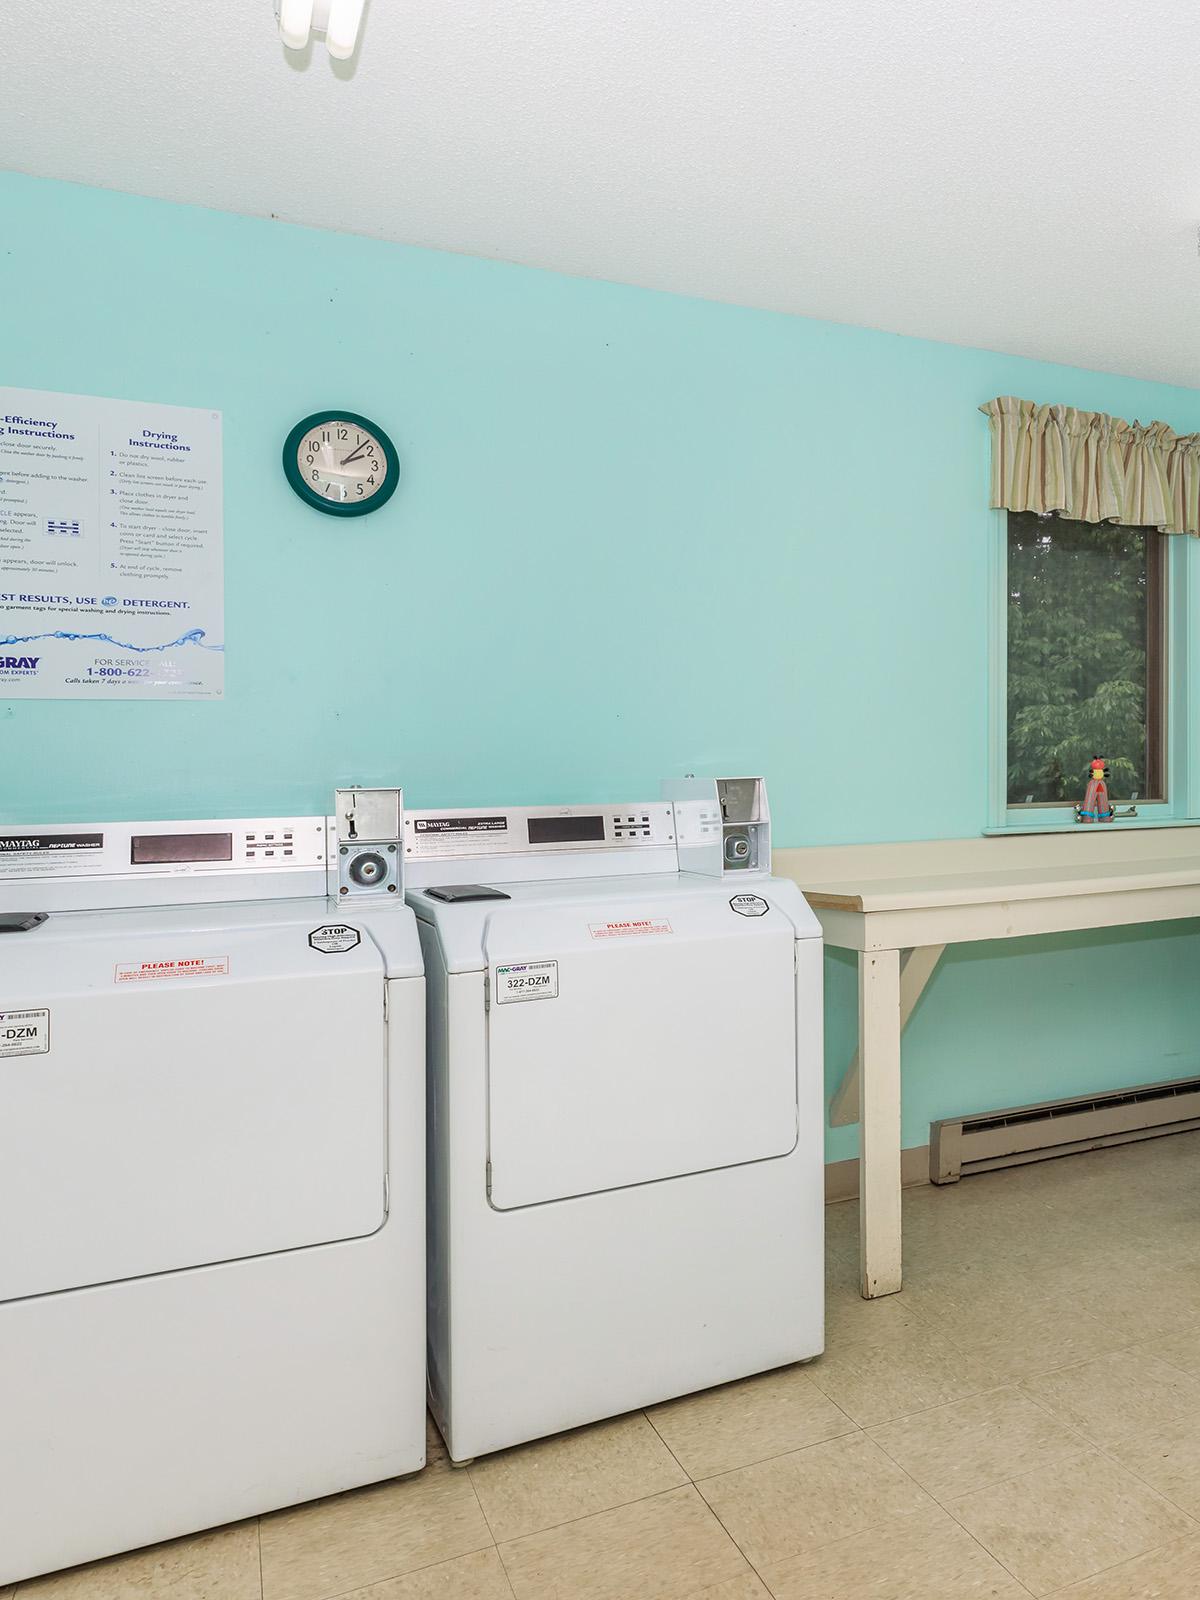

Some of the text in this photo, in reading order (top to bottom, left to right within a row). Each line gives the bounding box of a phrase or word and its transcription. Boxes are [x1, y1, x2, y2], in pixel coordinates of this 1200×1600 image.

[8, 426, 75, 440] Instructions
[142, 430, 178, 442] Drying
[322, 431, 330, 442] 11
[337, 429, 348, 440] 12
[129, 439, 191, 451] Instructions
[356, 434, 360, 445] 1
[309, 441, 320, 452] 10
[366, 445, 374, 457] 2
[306, 454, 314, 466] 9
[371, 460, 379, 472] 3
[311, 470, 319, 481] 8
[367, 475, 375, 485] 4
[356, 484, 364, 495] 5
[19, 594, 72, 605] RESULTS,
[76, 597, 97, 605] USE
[123, 599, 190, 609] DETERGENT.
[0, 839, 39, 848] MAYTAG
[141, 959, 204, 970] PLEASE NOTE!
[507, 976, 550, 988] 322-DZM
[1, 1027, 37, 1039] -DZM
